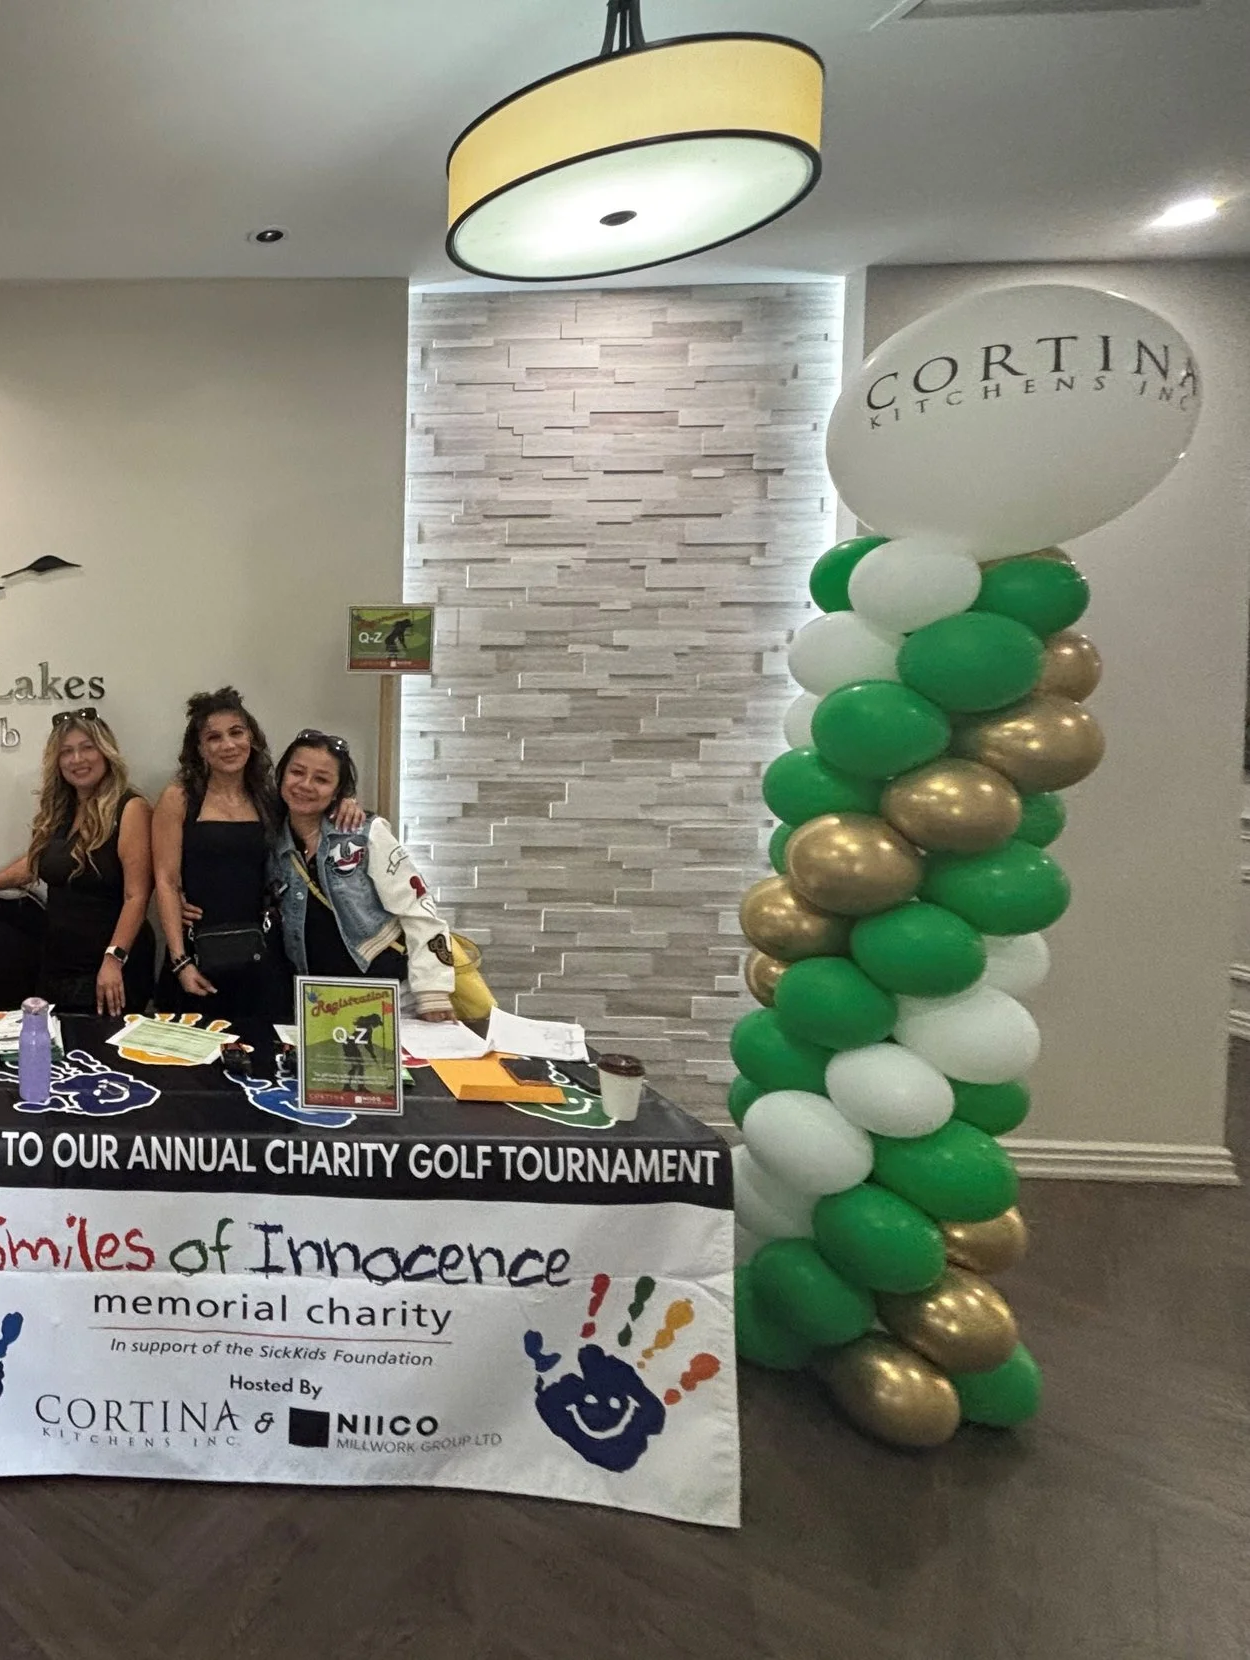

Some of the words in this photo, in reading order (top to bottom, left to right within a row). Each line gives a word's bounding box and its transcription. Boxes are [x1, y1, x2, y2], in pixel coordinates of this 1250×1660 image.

[867, 335, 1198, 410] CORTINA
[869, 376, 1107, 430] KITCHENS
[1138, 380, 1188, 412] INC
[358, 631, 383, 644] Q-Z
[311, 990, 390, 1017] Registration
[332, 1026, 369, 1045] Q-Z
[2, 1131, 43, 1167] TO
[52, 1132, 120, 1170] OUR
[126, 1135, 257, 1173] ANNUAL
[264, 1139, 400, 1178] CHARITY
[408, 1143, 492, 1180] GOLF
[499, 1145, 720, 1186] TOURNAMENT
[169, 1217, 235, 1277] of
[245, 1221, 571, 1287] Innocence
[94, 1293, 287, 1321] memorial
[306, 1297, 452, 1335] charity
[111, 1338, 126, 1351] In
[132, 1340, 198, 1356] support
[202, 1340, 223, 1354] of
[226, 1342, 254, 1357] the
[259, 1344, 327, 1361] SickKids
[333, 1350, 433, 1367] Foundation
[230, 1374, 294, 1392] Hosted
[300, 1379, 323, 1400] By
[35, 1394, 244, 1434] CORTINA
[254, 1411, 276, 1434] &
[337, 1413, 439, 1437] NIICO
[42, 1427, 171, 1448] KITCHENS
[336, 1438, 416, 1453] MILLWORK
[420, 1435, 472, 1452] GROUP
[475, 1432, 503, 1447] LTD
